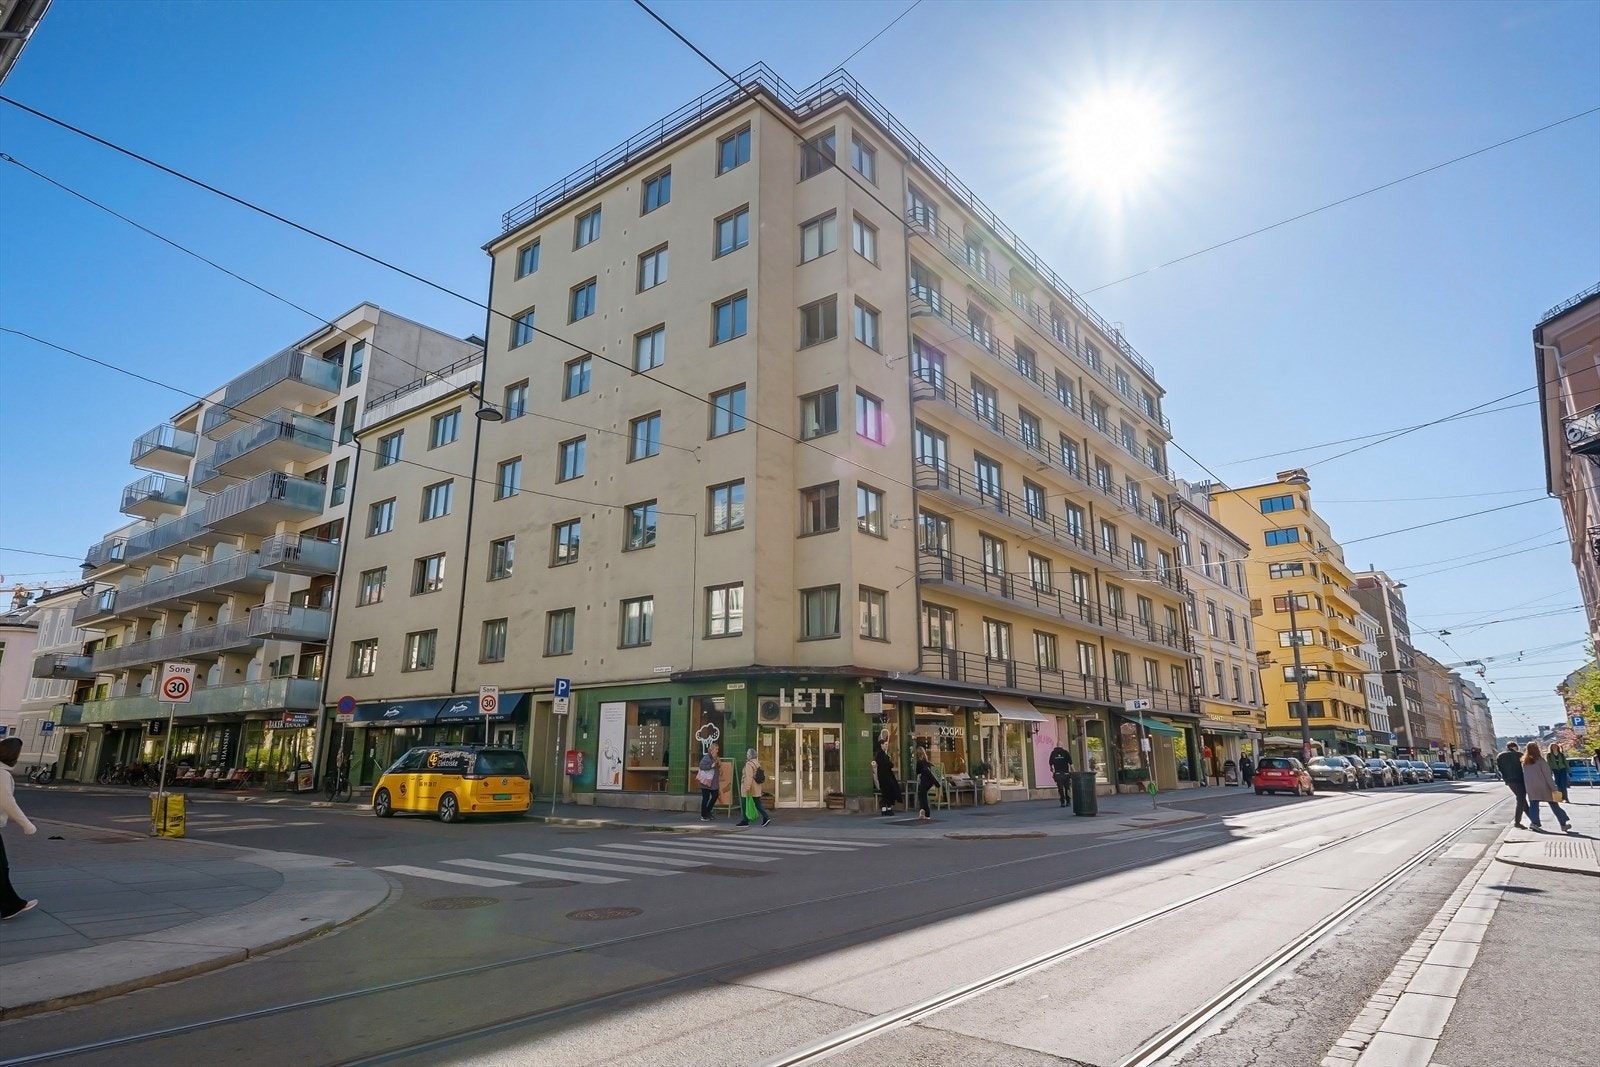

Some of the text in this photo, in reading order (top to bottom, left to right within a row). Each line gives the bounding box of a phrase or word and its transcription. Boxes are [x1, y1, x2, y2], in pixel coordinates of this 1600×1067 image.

[169, 665, 191, 673] Sone
[169, 682, 185, 693] 30
[558, 680, 567, 695] P
[780, 688, 834, 708] LETT
[1574, 717, 1582, 726] P
